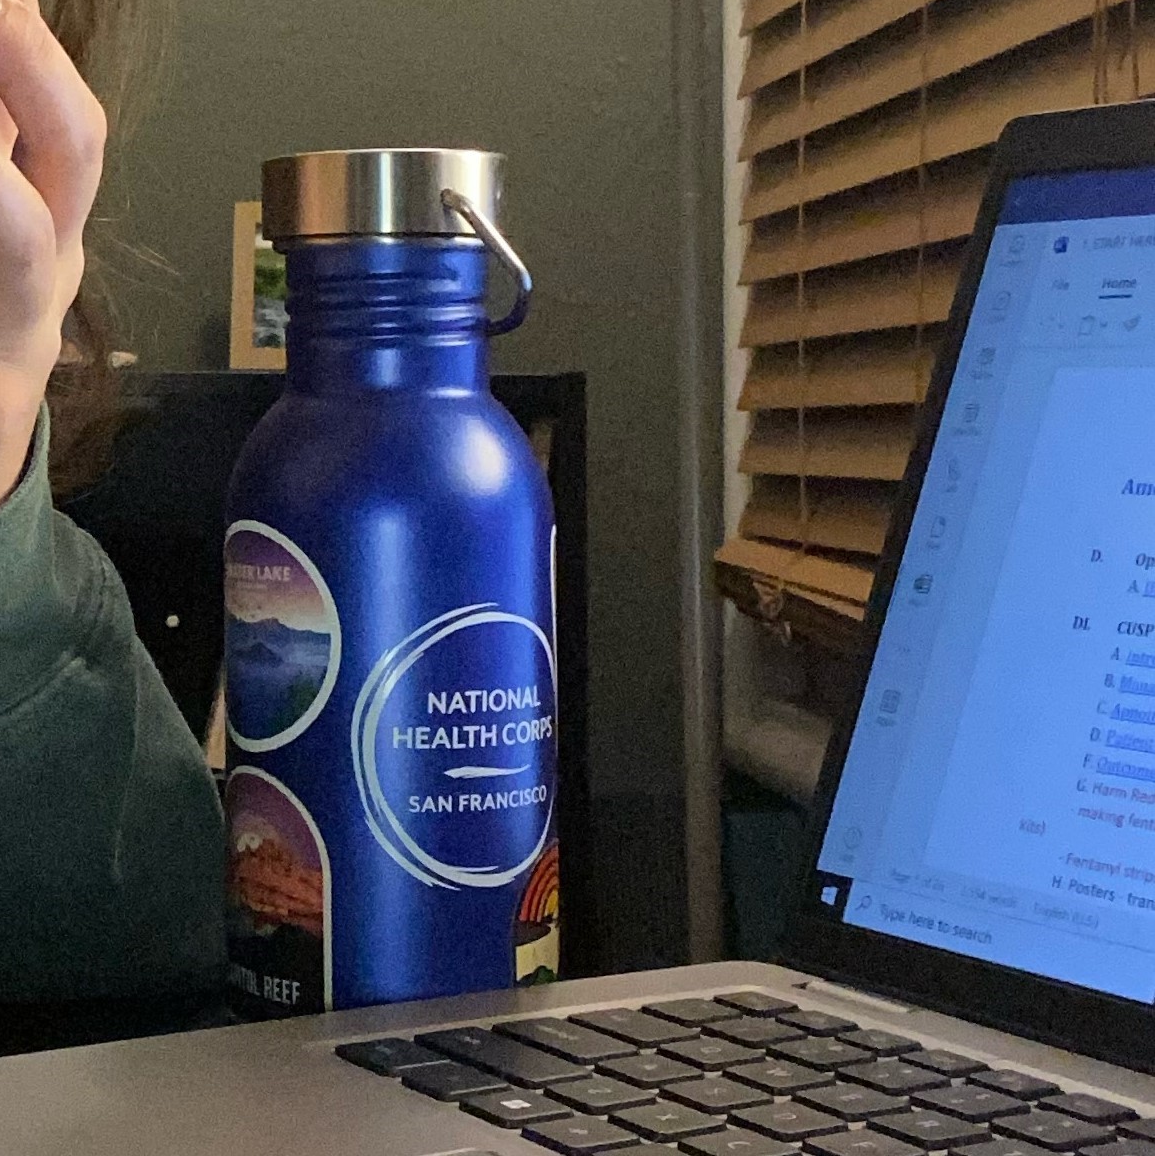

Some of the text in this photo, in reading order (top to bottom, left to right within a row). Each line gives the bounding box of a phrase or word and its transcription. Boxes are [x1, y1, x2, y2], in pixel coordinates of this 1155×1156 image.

[256, 565, 292, 582] LAKE
[1116, 620, 1155, 638] CUSP
[426, 684, 541, 716] NATIONAL
[391, 714, 554, 751] HEALTH CORPS
[408, 784, 548, 815] SAN FRANCISCO
[1092, 780, 1128, 800] Harm
[1077, 806, 1126, 829] making
[1068, 878, 1116, 903] Posters
[880, 902, 993, 945] Type here to search
[263, 975, 301, 1005] REEF
